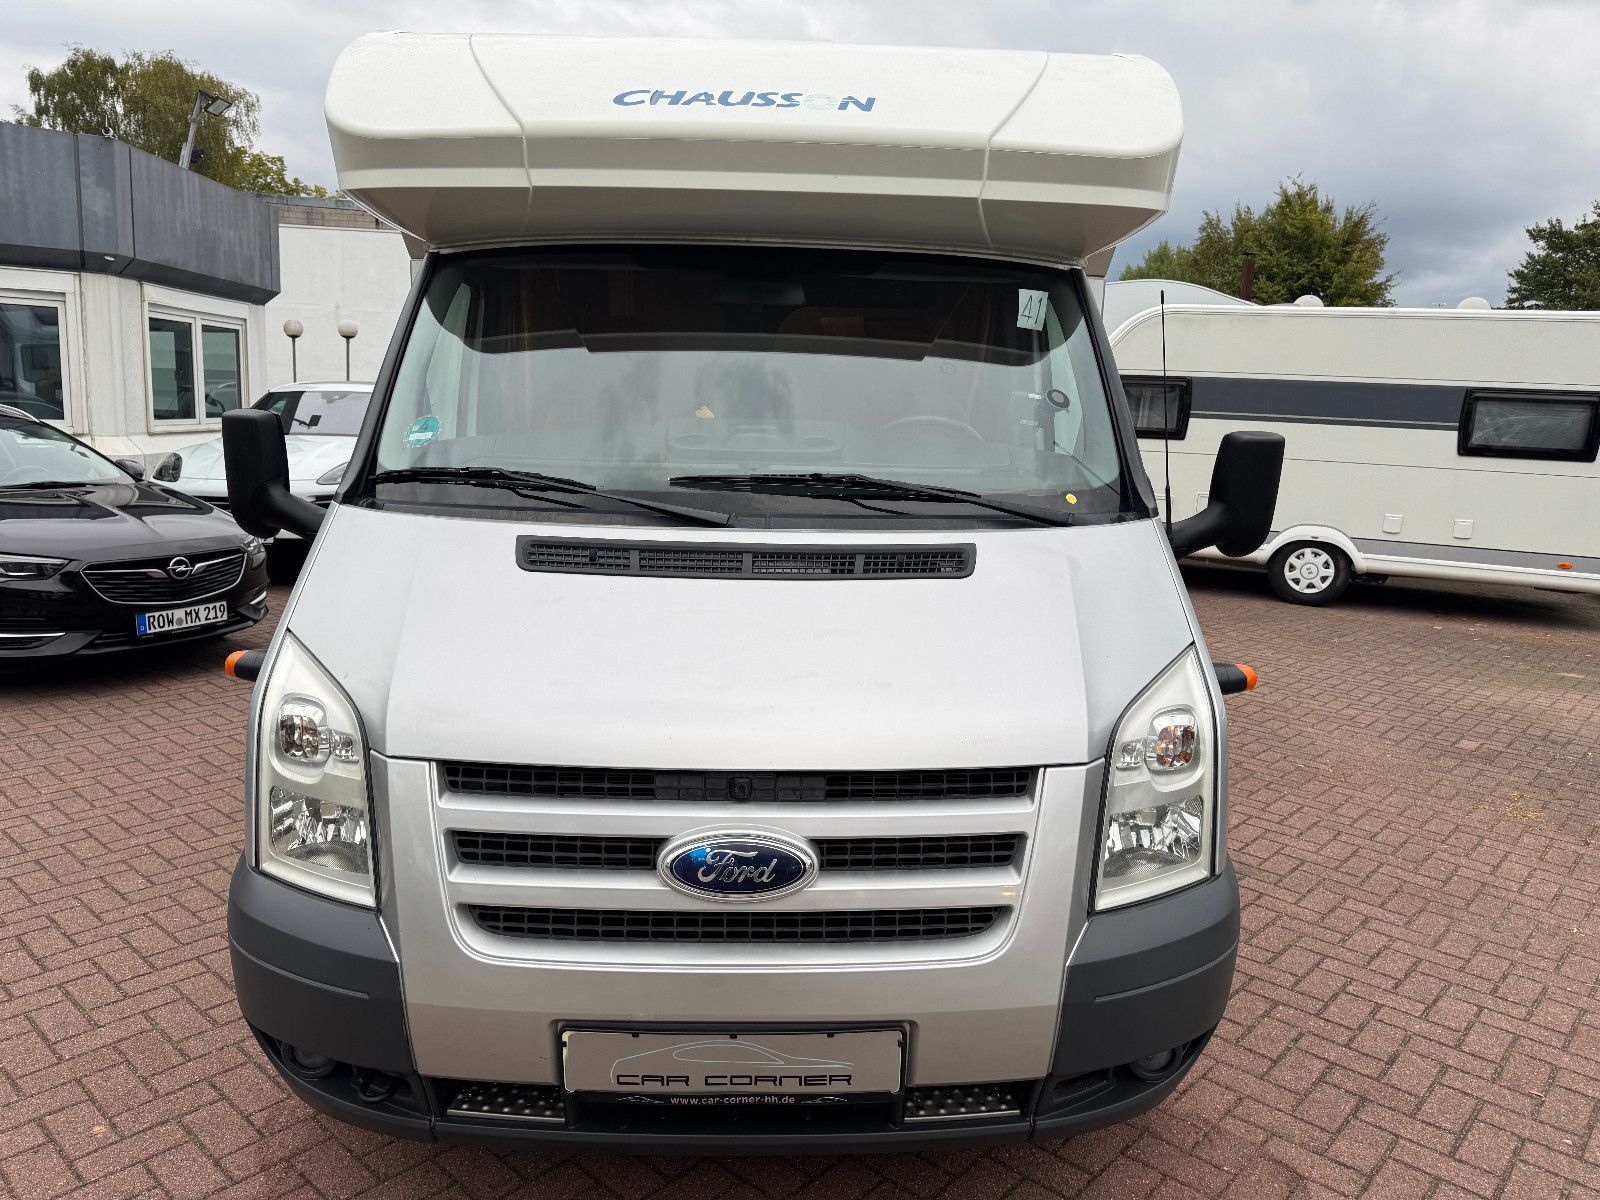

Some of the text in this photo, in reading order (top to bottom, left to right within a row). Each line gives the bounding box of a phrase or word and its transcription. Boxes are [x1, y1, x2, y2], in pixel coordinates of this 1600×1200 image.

[1020, 294, 1043, 325] 41
[147, 612, 175, 631] ROW
[184, 607, 202, 625] MX
[203, 603, 226, 621] 219
[697, 849, 778, 883] Ford
[616, 1074, 852, 1087] CAR CORNER
[670, 1095, 796, 1105] www.car-corner-hh.de
